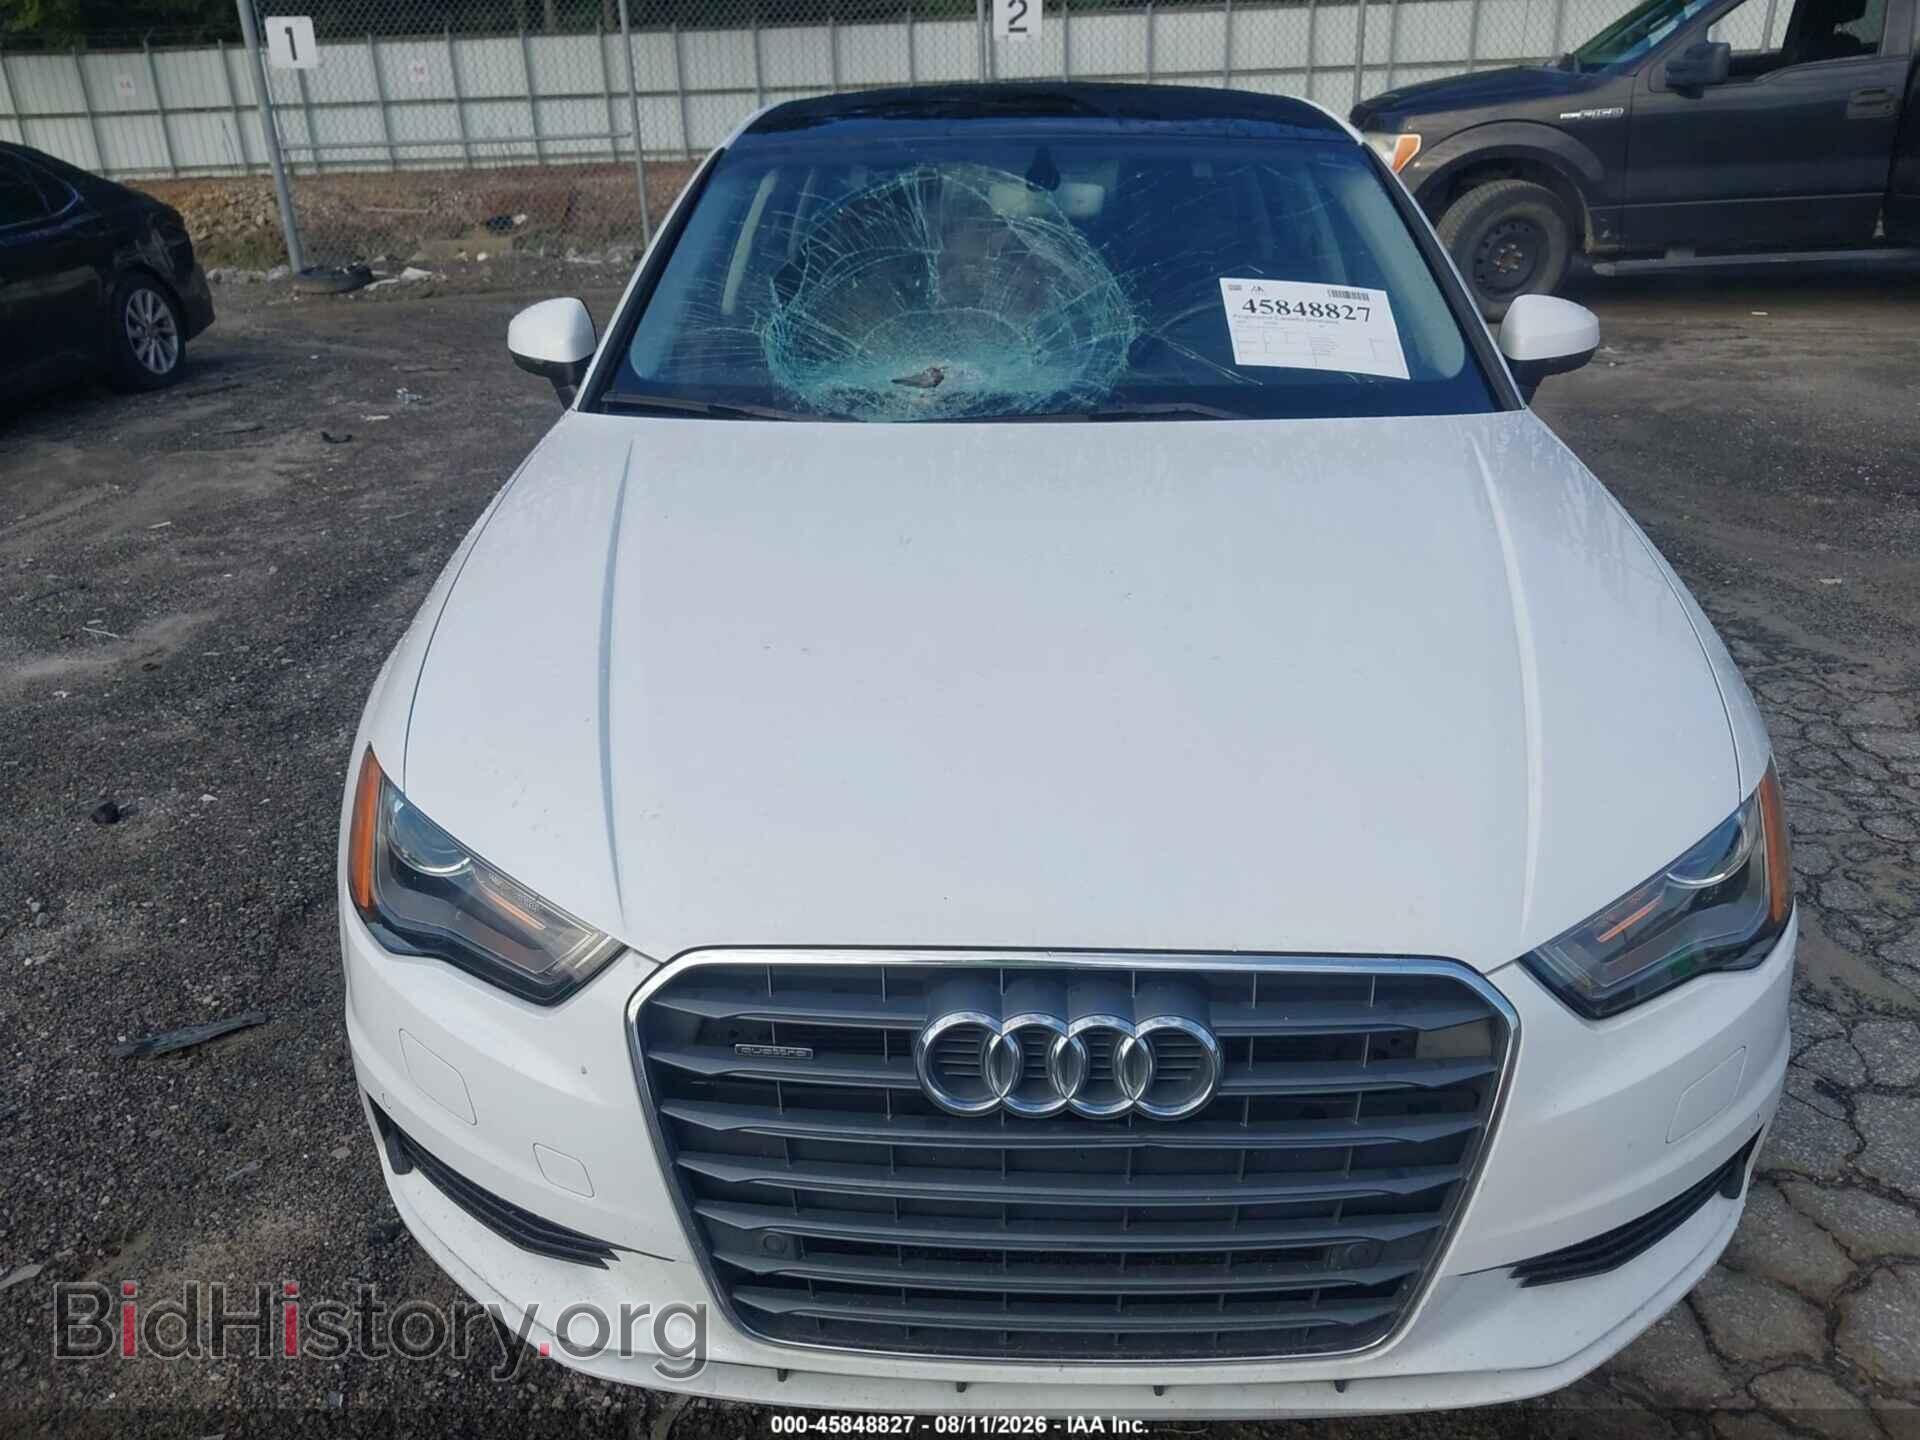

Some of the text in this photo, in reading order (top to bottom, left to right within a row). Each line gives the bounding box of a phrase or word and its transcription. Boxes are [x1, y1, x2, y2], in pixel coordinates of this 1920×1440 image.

[1008, 0, 1027, 32] 2
[284, 27, 297, 60] 1
[1242, 298, 1371, 322] 45848827
